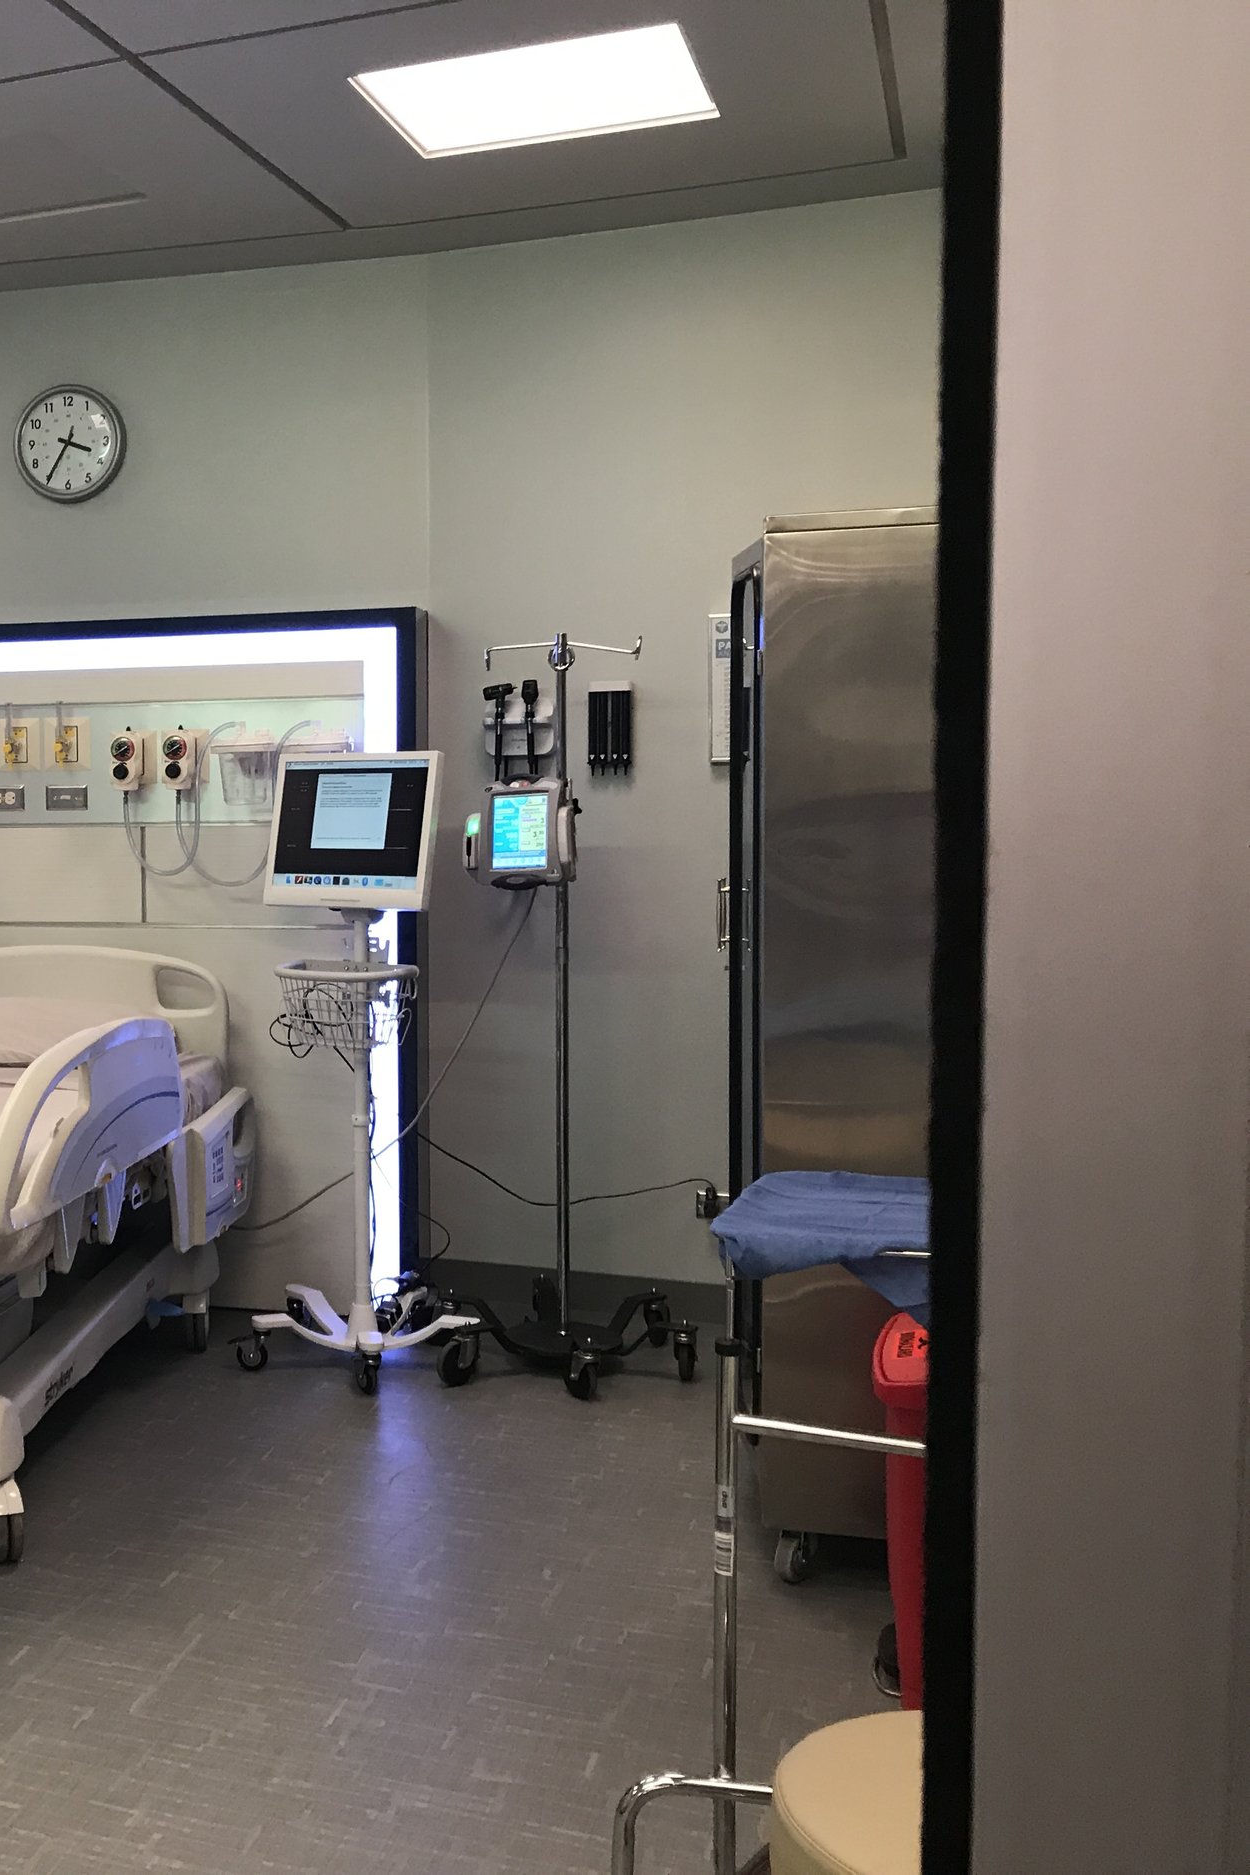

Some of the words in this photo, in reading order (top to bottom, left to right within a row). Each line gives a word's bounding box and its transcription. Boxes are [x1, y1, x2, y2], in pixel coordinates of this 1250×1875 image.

[62, 395, 74, 407] 12
[85, 401, 89, 411] 1
[44, 402, 54, 414] 11
[30, 418, 42, 430] 10
[98, 414, 106, 425] 2
[29, 440, 35, 450] 9
[102, 435, 110, 447] 3
[32, 458, 39, 469] 8
[96, 457, 104, 466] 4
[84, 472, 92, 484] 5
[64, 479, 71, 490] 6
